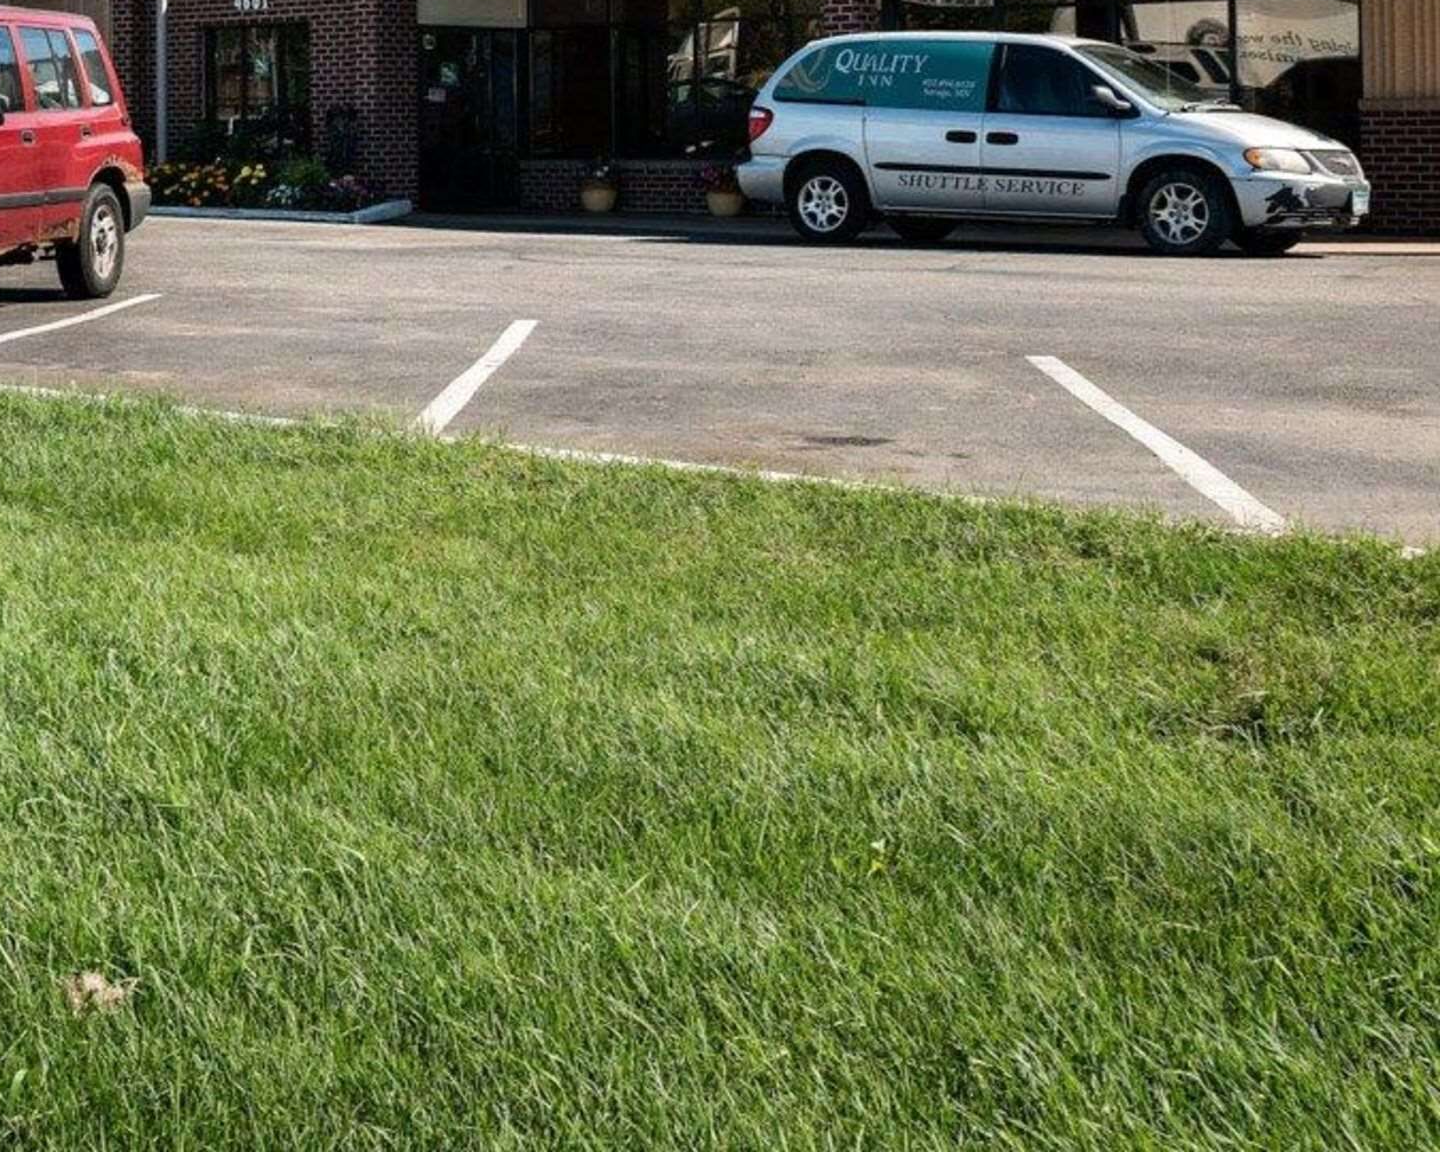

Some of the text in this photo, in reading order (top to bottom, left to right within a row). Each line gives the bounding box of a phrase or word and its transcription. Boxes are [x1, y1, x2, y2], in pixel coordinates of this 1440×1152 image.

[835, 48, 929, 74] QUALITY
[857, 74, 893, 87] INN
[898, 173, 1086, 196] SHUTTLE SERVICE
